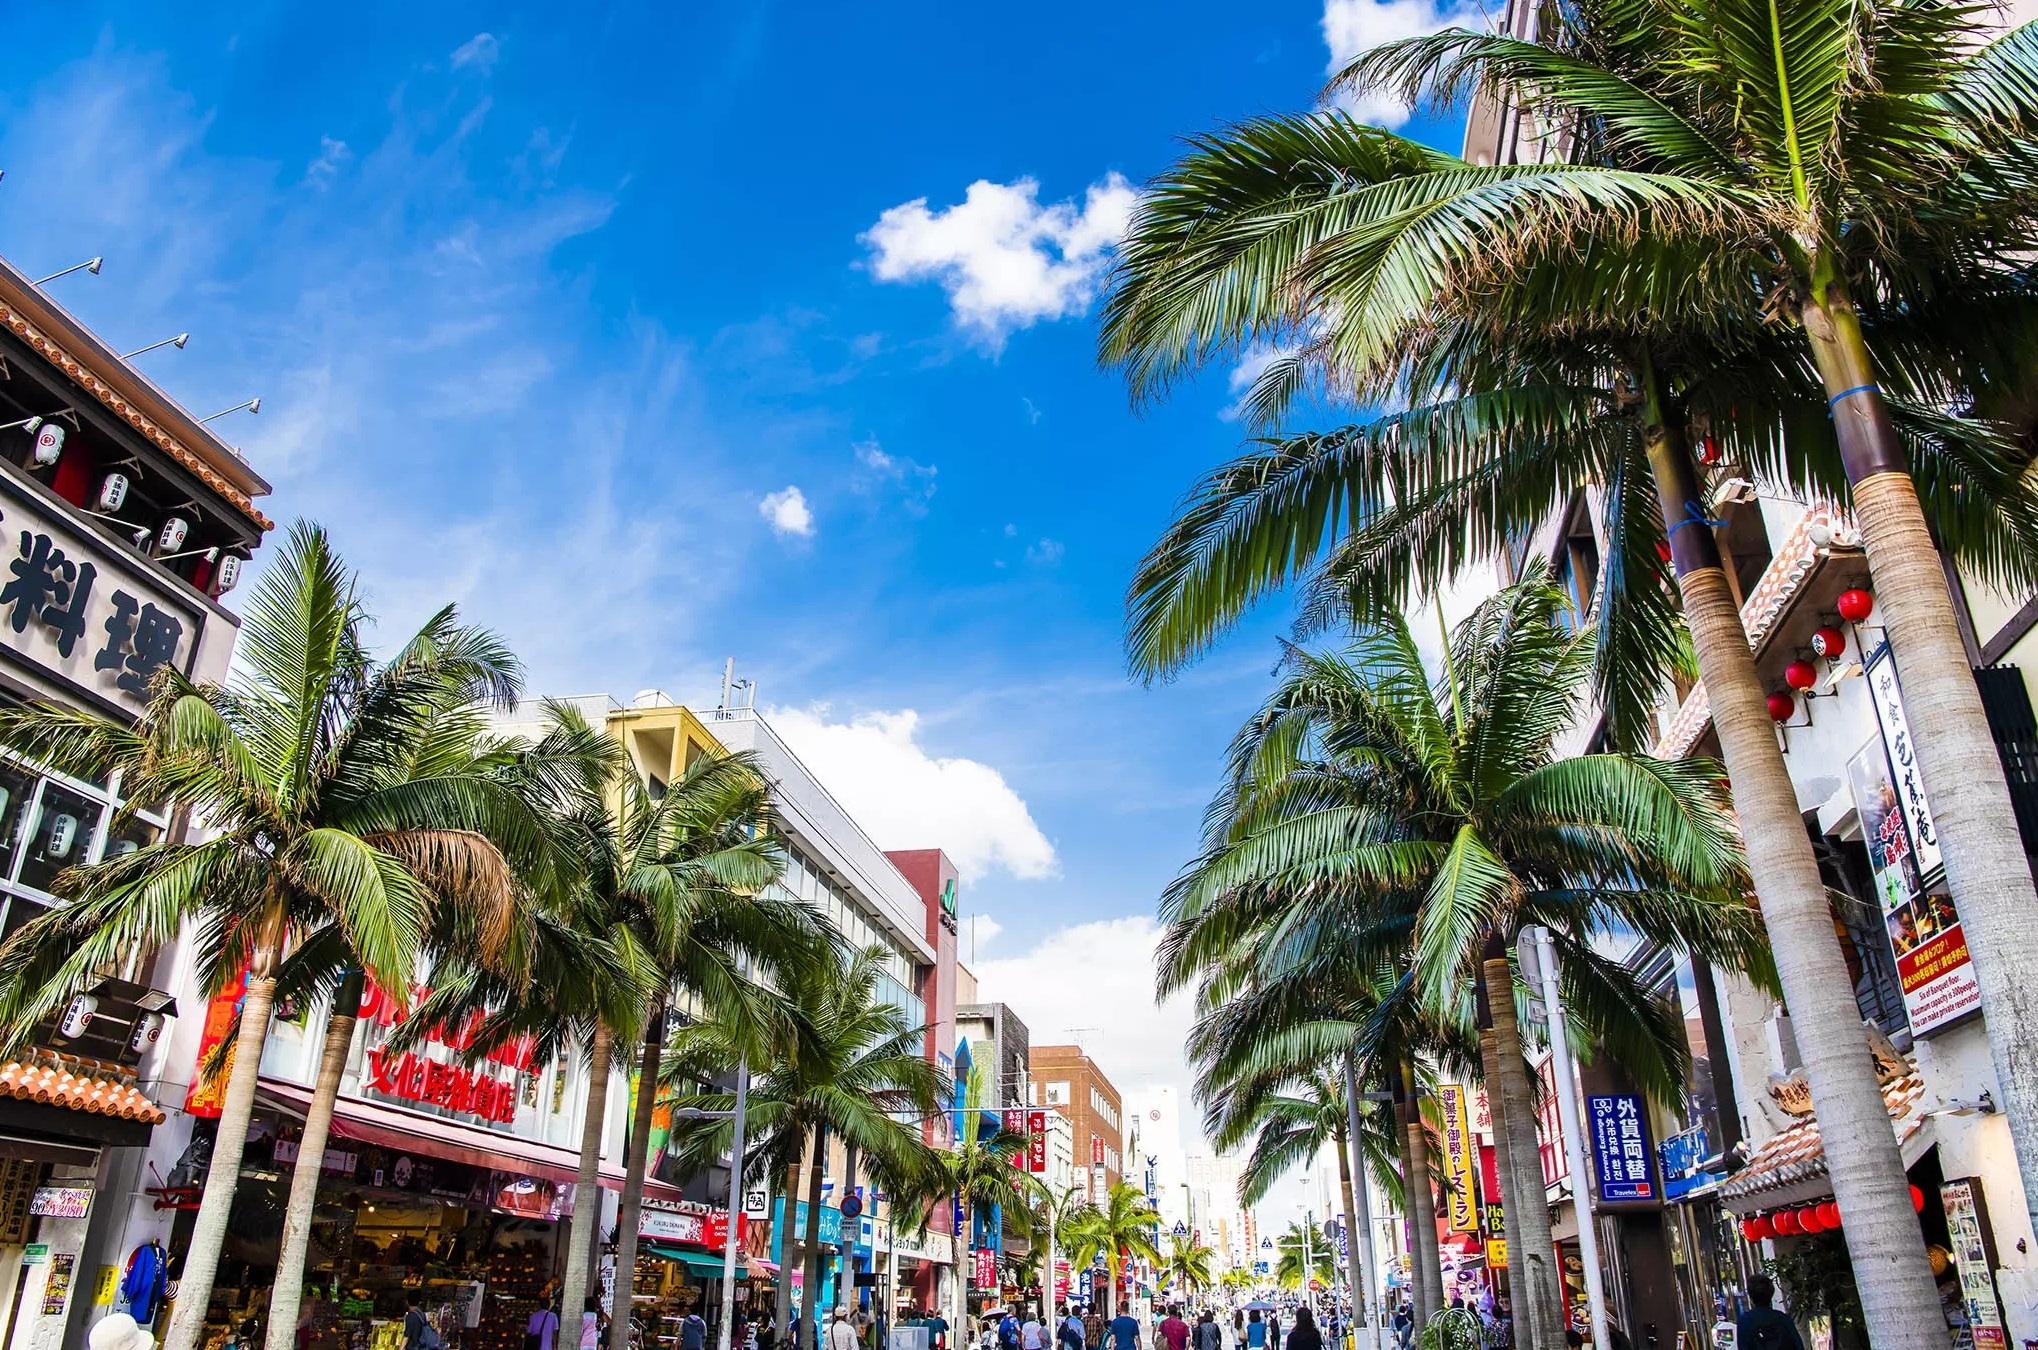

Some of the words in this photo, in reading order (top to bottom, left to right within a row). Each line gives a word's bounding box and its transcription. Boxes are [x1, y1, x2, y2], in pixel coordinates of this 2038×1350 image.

[0, 528, 184, 702] 料理
[1911, 1003, 1931, 1018] Maximum
[1931, 994, 1949, 1010] capacity
[1912, 1018, 1920, 1028] You
[1927, 1010, 1939, 1023] make
[1939, 1003, 1955, 1020] private
[1597, 1118, 1606, 1150] Exchange
[1617, 1098, 1646, 1180] 外貨両替
[1442, 1088, 1471, 1228] 御菓子御殿のレストラン
[1602, 1150, 1611, 1181] Currency
[1613, 1188, 1637, 1196] Travelex
